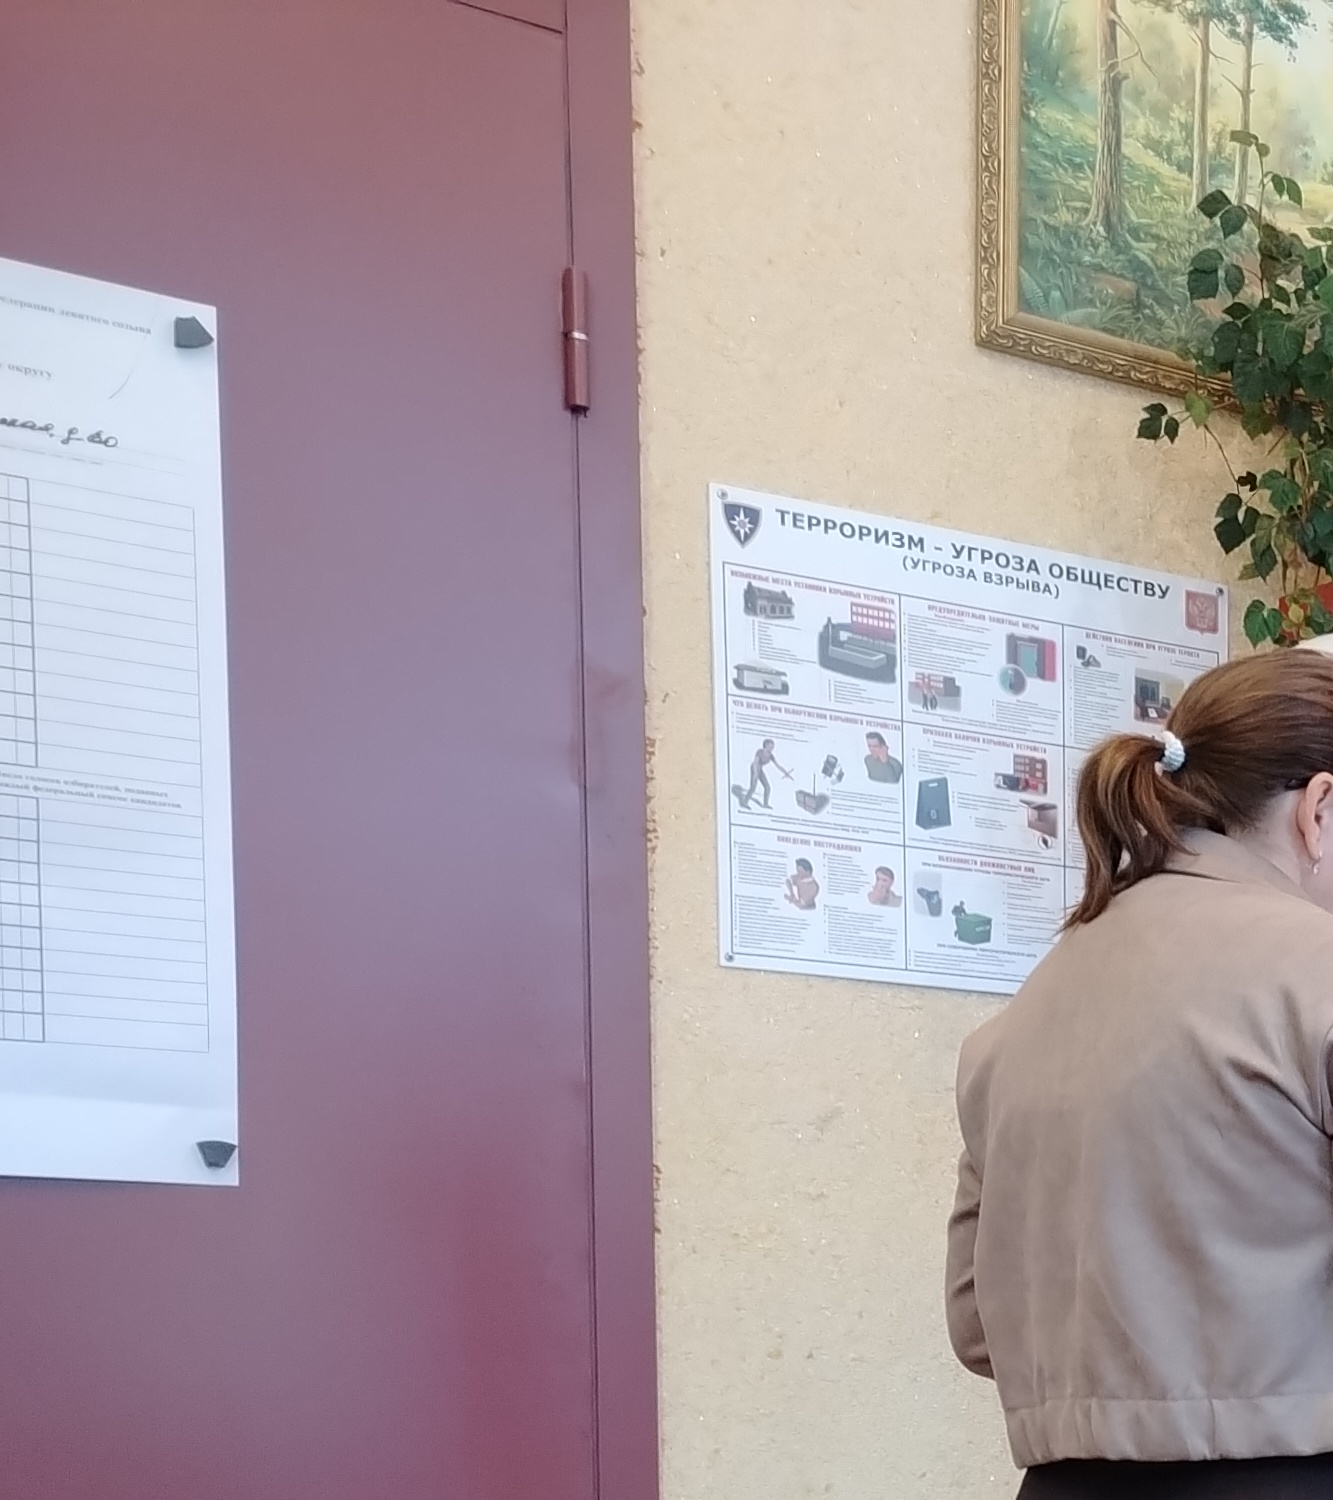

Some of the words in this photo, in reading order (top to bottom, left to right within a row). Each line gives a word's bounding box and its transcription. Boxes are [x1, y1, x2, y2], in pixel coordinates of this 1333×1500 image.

[775, 508, 925, 553] ТЕРРОРИЗМ
[951, 542, 1041, 576] УГРОЗА
[1049, 563, 1171, 600] ОБЩЕСТВУ
[902, 555, 977, 582] (УГРОЗА
[983, 573, 1060, 600] ВЗРЫВА)
